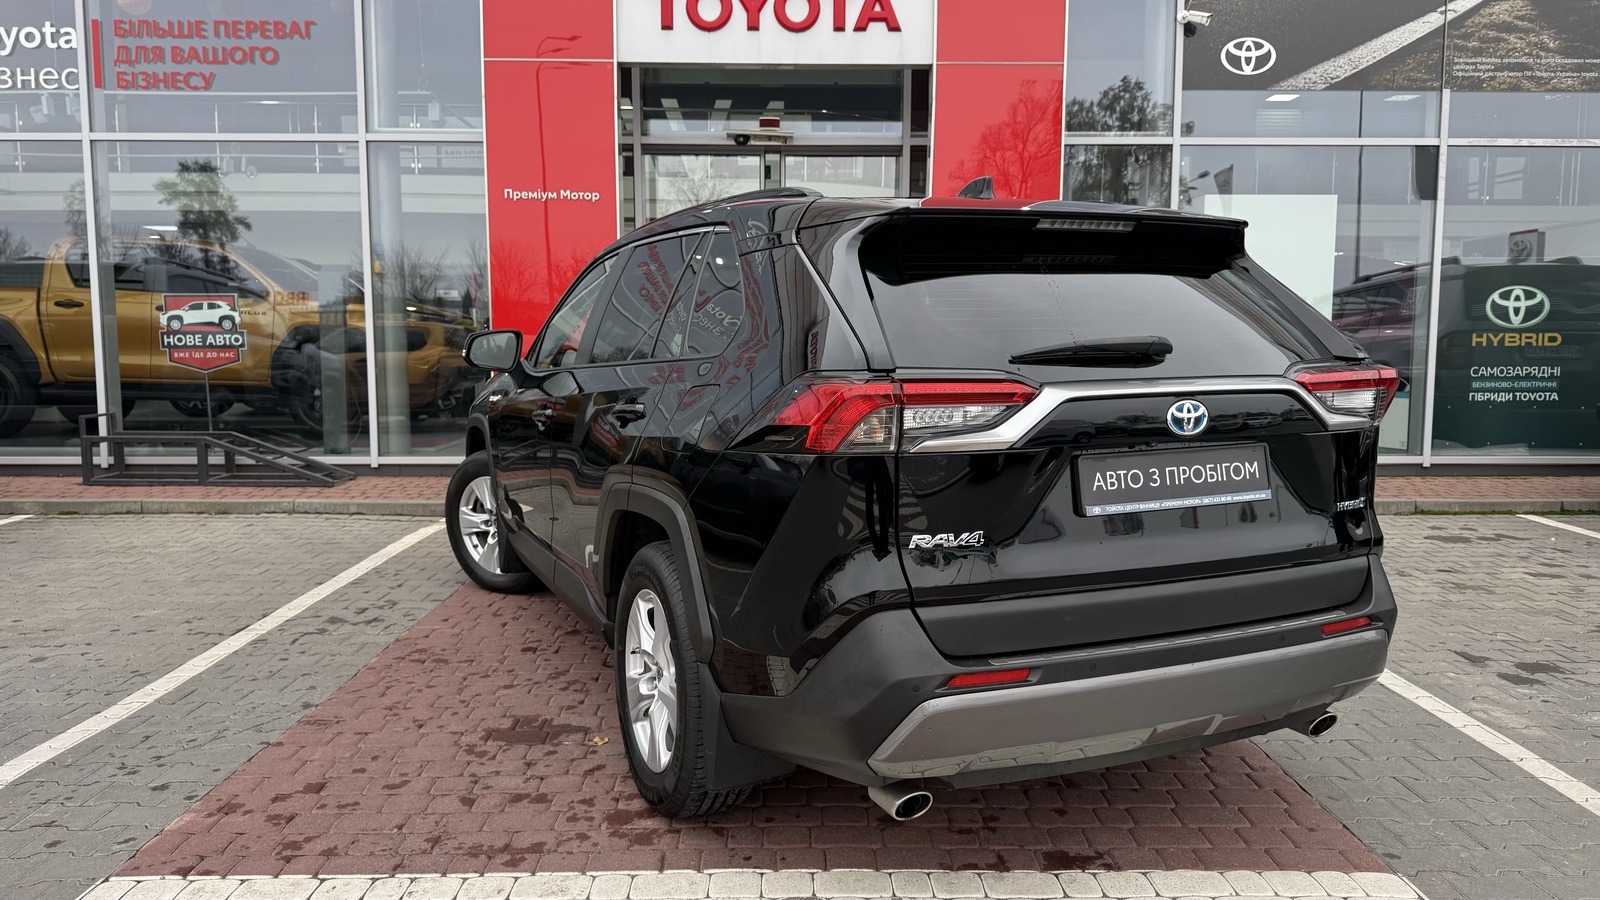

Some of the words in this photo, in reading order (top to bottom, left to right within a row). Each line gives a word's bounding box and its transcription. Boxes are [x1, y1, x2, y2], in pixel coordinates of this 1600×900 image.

[113, 19, 206, 39] БІЛЬШЕ
[213, 19, 315, 39] ПЕРЕВАГ
[113, 45, 164, 67] ДЛЯ
[170, 45, 279, 66] ВАШОГО
[115, 70, 215, 91] БІЗНЕСУ
[504, 188, 557, 202] Преміум
[560, 189, 600, 203] Мотор
[163, 334, 203, 346] НОВЕ
[206, 334, 243, 346] АВТО
[1472, 333, 1562, 347] HYBRID
[192, 351, 205, 359] ЇДЕ
[206, 351, 218, 359] ДО
[1470, 366, 1561, 378] САМОЗАРЯДНІ
[1469, 392, 1513, 402] ГІБРИДИ
[1514, 392, 1559, 401] TOYOTA
[1092, 469, 1145, 492] АВТО
[1148, 468, 1161, 487] З
[1165, 460, 1260, 486] ПРОБІГОМ
[908, 530, 986, 549] RAV4
